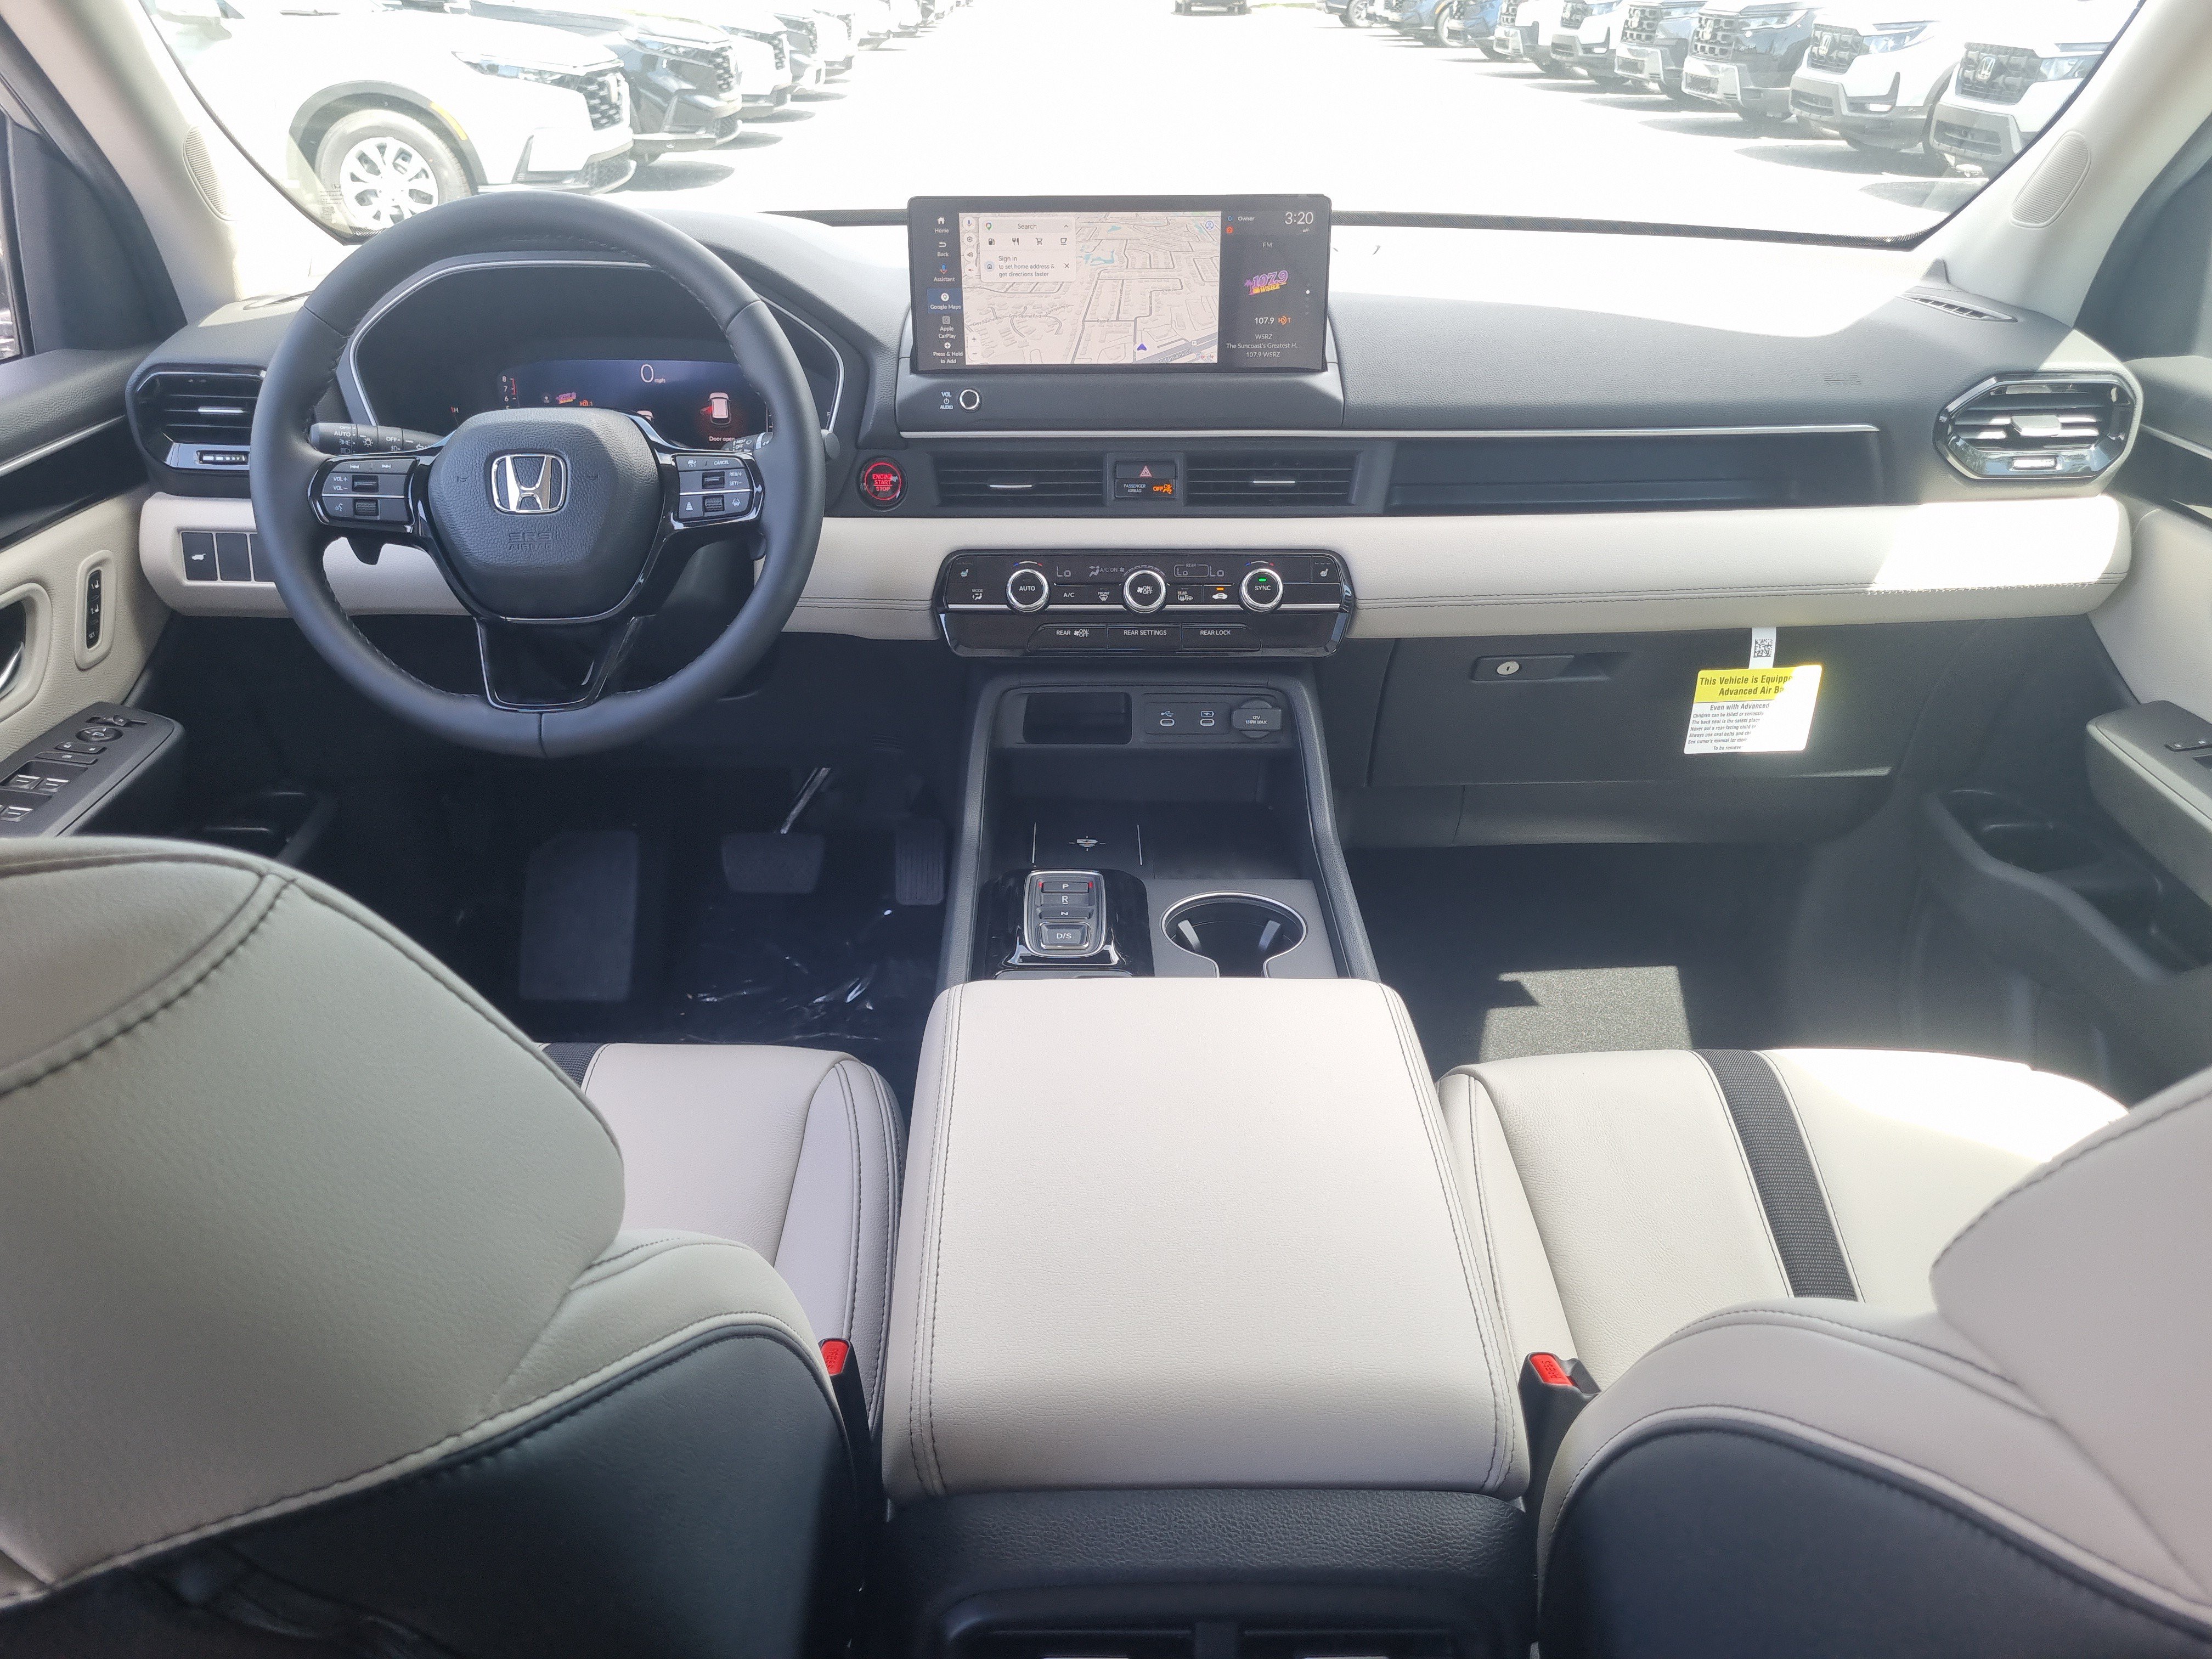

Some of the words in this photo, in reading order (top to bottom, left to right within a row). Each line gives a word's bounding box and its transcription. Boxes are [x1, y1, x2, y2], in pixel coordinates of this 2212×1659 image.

[1285, 212, 1314, 225] 3:20
[1252, 270, 1288, 289] 107.9
[1260, 283, 1280, 292] WSRZ
[640, 363, 655, 383] 0
[1700, 677, 1716, 686] This
[1719, 676, 1749, 685] Vehicle
[1751, 675, 1758, 684] is
[1719, 687, 1757, 696] Advanced
[1760, 686, 1772, 695] Air
[1542, 1360, 1561, 1378] PRESS
